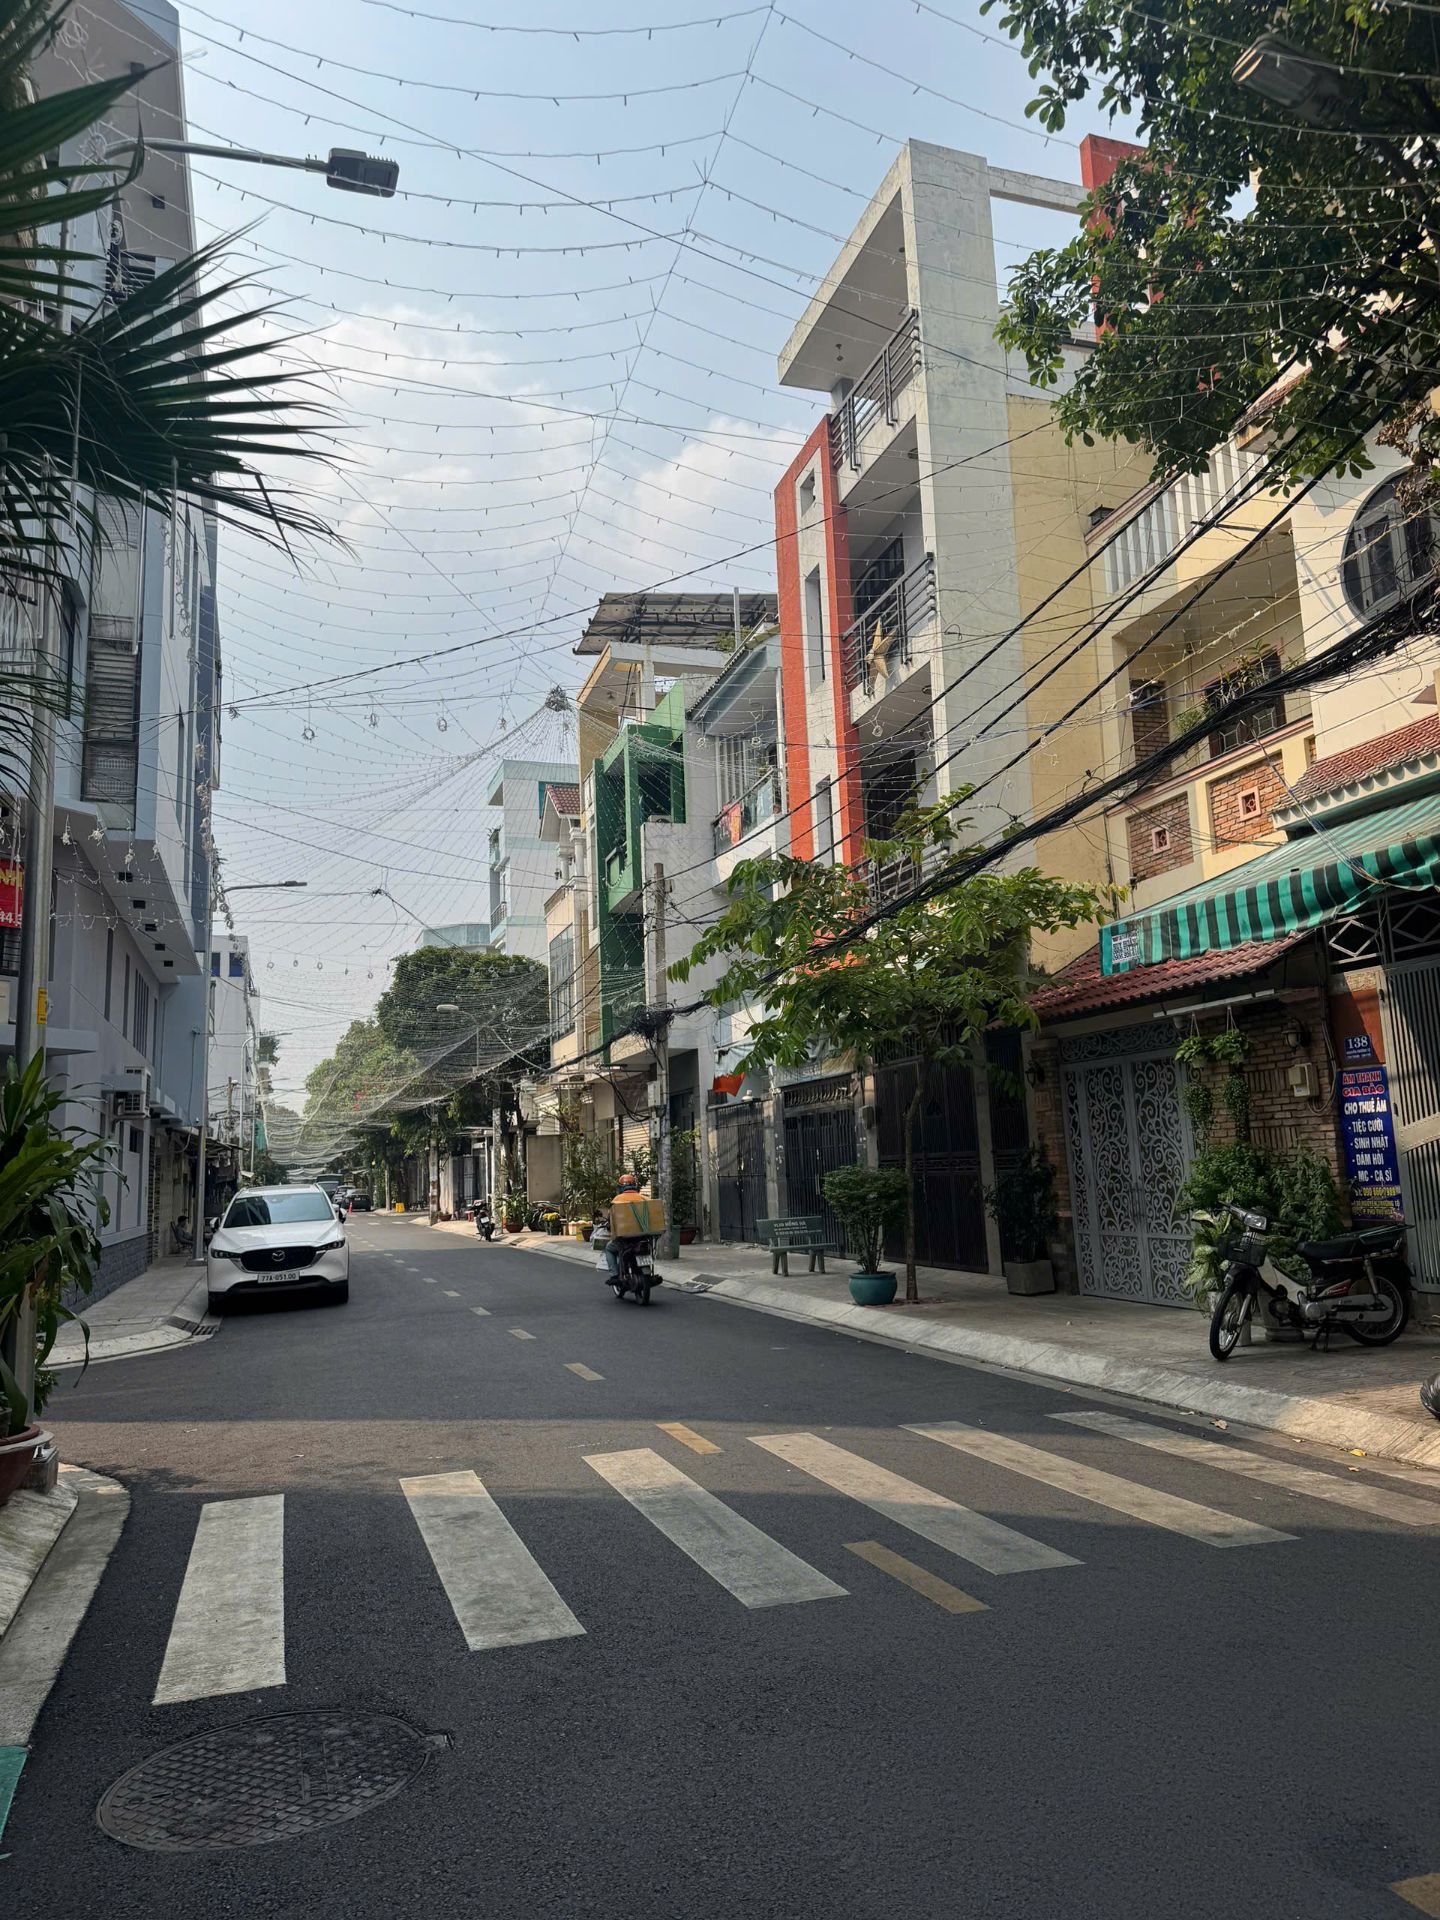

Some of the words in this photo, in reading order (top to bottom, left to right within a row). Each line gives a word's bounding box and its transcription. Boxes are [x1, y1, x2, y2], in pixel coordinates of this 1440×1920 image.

[1347, 1036, 1368, 1049] 138
[1356, 1071, 1382, 1084] THANH
[1342, 1087, 1361, 1097] GIA
[1344, 1102, 1358, 1115] CHO
[1359, 1097, 1375, 1114] THUÊ
[1354, 1137, 1370, 1149] SINH
[1358, 1170, 1369, 1182] MC
